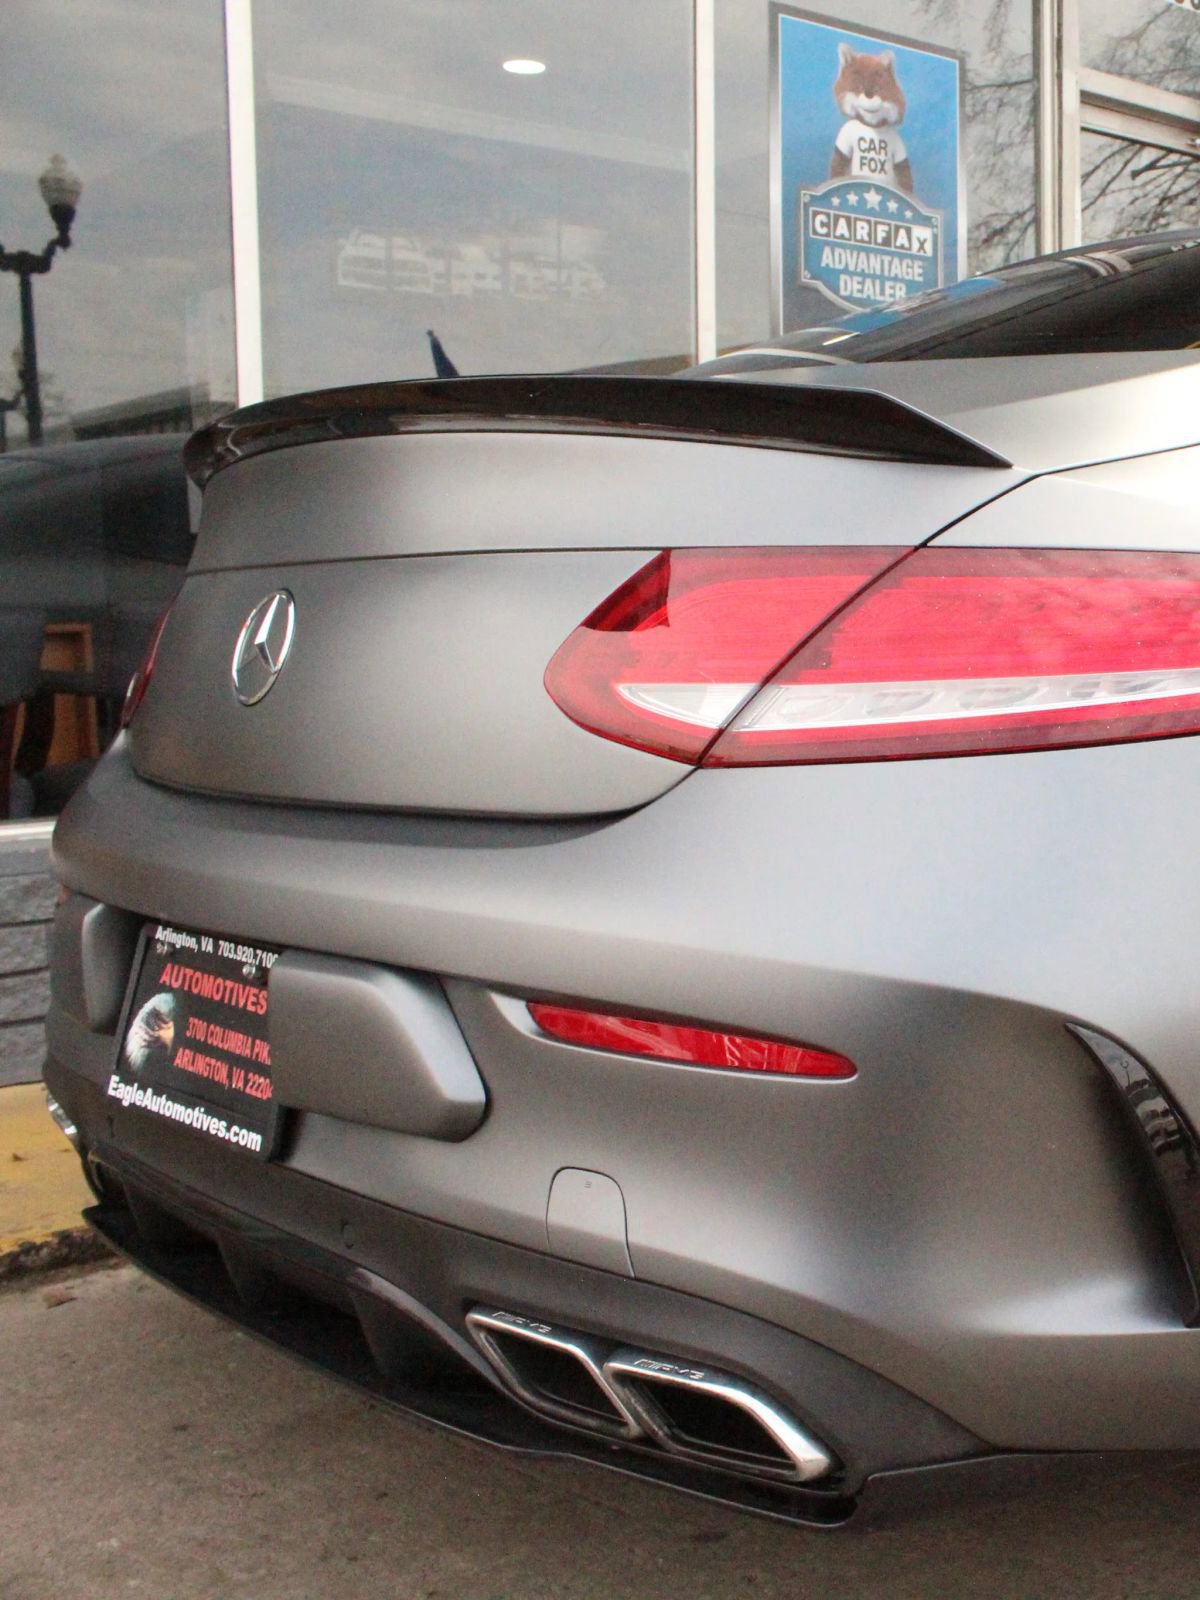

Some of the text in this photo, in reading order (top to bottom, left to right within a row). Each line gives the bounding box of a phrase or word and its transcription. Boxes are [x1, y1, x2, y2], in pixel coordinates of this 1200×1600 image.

[857, 137, 888, 157] CAR
[859, 156, 887, 175] FOX
[814, 213, 928, 255] CARFAX
[820, 246, 924, 282] ADVANTAGE
[839, 273, 907, 303] DEALER
[155, 925, 198, 952] Arlington,
[201, 937, 214, 954] VA
[159, 963, 269, 1016] AUTOMOTIVES
[207, 1023, 252, 1060] COLUMBIA
[252, 1039, 272, 1066] PIK
[173, 1047, 229, 1090] ARLINGTON,
[231, 1066, 244, 1090] VA
[107, 1075, 262, 1152] EagleAutomotives.com
